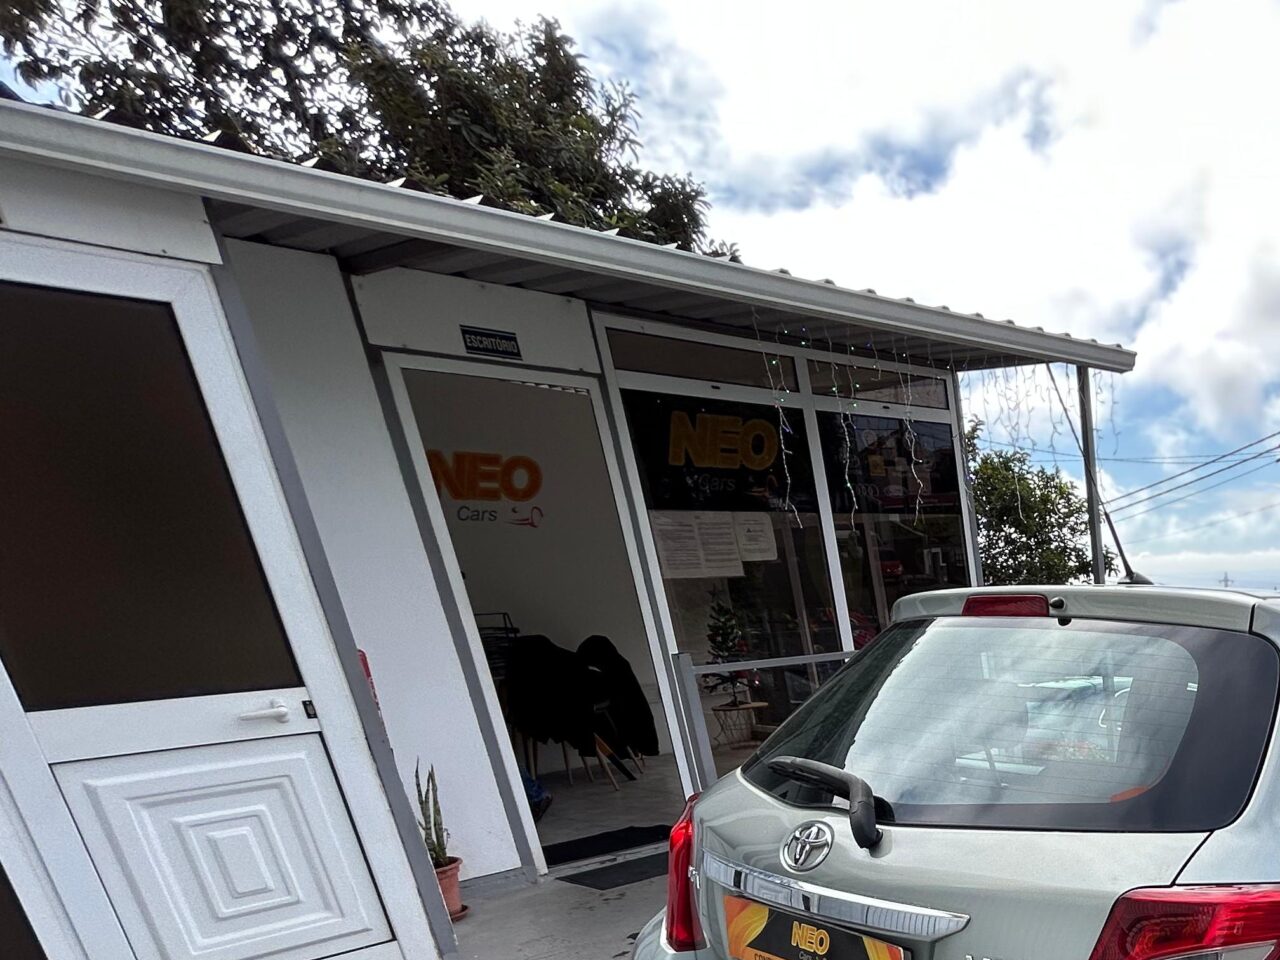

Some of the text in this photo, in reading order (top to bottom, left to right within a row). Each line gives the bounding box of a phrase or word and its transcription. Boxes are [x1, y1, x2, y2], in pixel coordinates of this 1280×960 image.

[668, 410, 778, 471] NEO
[427, 449, 543, 502] NEO
[698, 473, 736, 491] Cars
[457, 505, 498, 521] Cars
[791, 921, 830, 955] NEO
